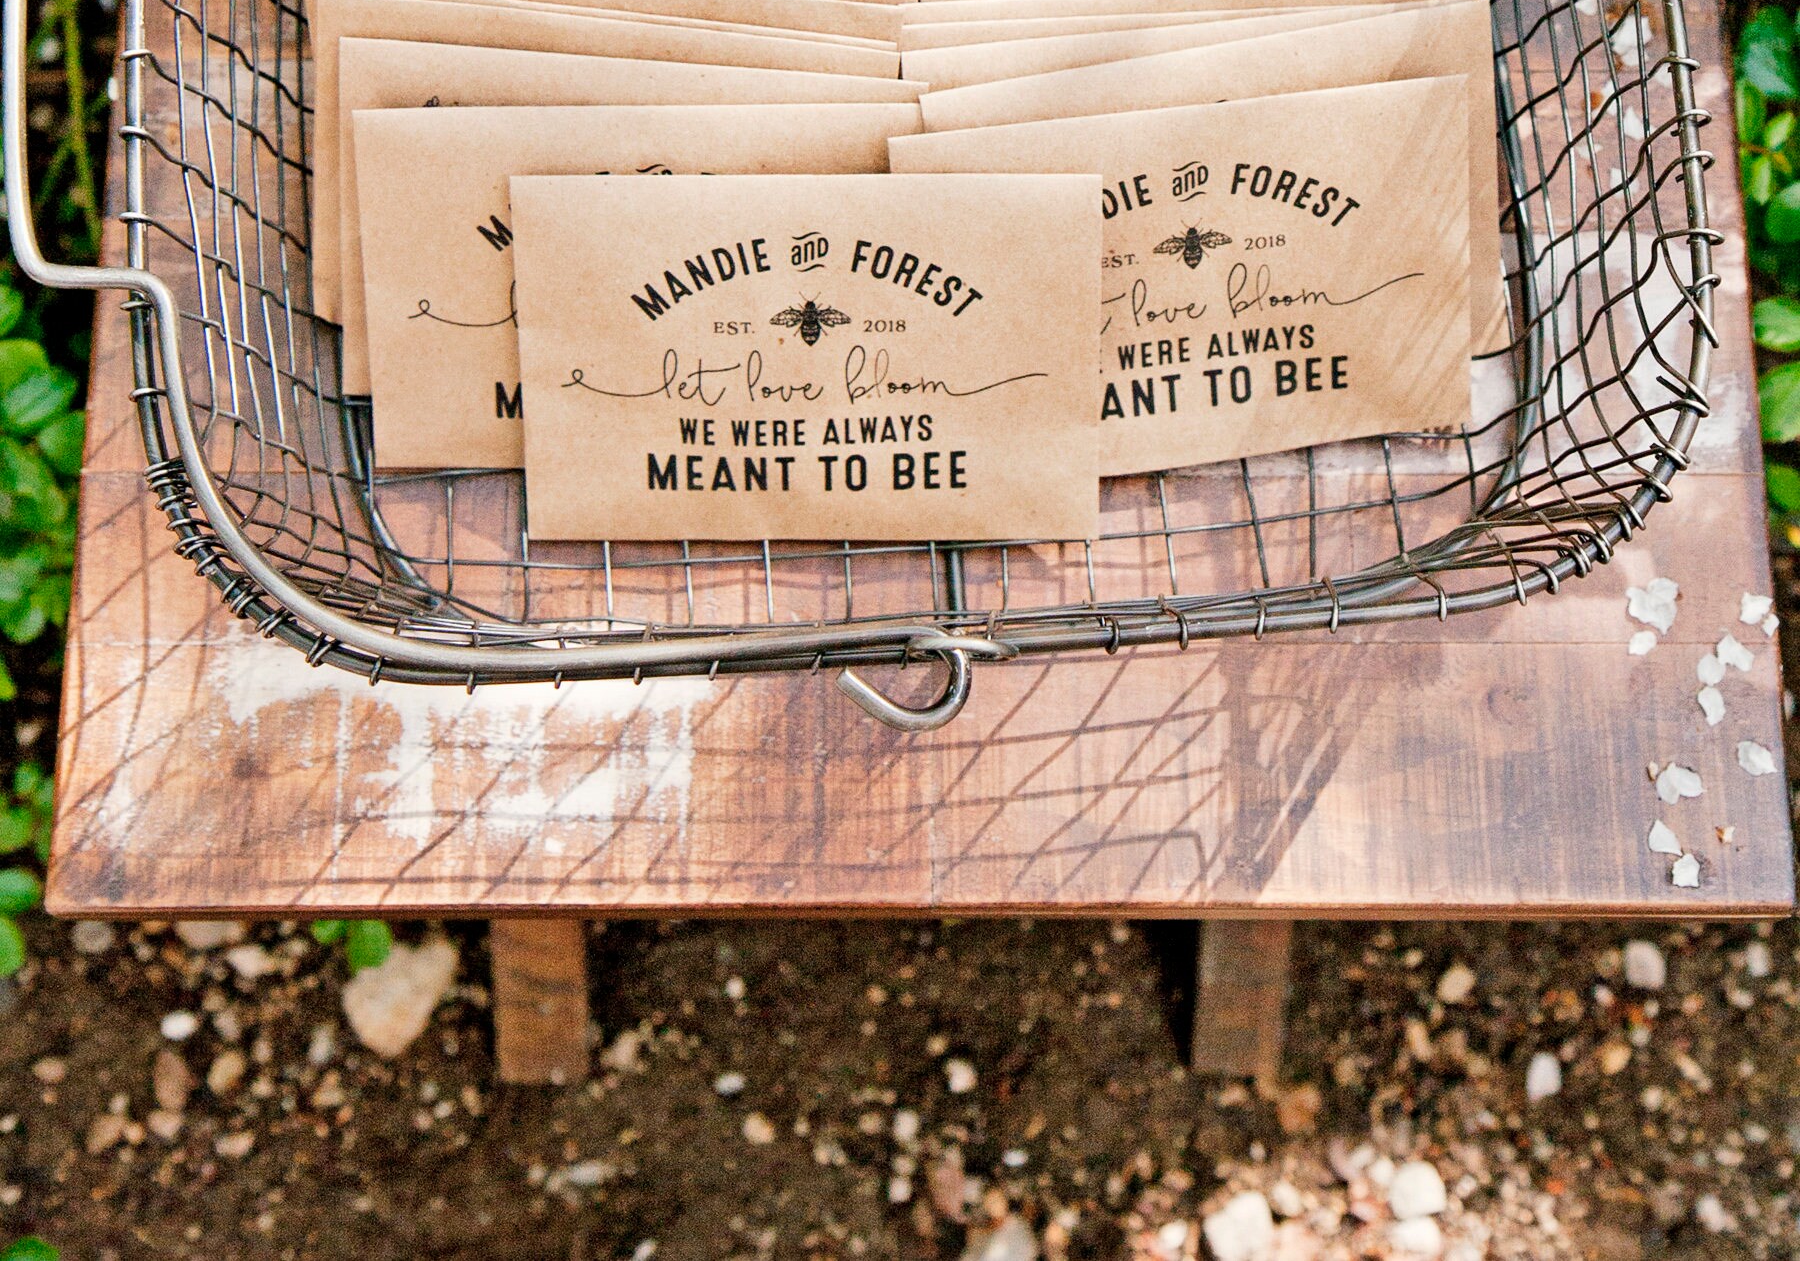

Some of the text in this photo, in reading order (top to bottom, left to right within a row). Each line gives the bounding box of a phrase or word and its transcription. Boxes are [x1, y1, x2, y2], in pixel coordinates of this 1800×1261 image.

[1231, 164, 1360, 226] FOREST
[1245, 235, 1285, 250] 2018
[630, 238, 771, 320] MANDIE
[850, 240, 983, 318] FOREST
[1132, 279, 1206, 327] love
[1228, 263, 1424, 318] bloom
[713, 319, 907, 335] EST. 2018
[1118, 337, 1190, 370] WERE
[1207, 324, 1316, 359] ALWAYS
[747, 350, 823, 402] love
[846, 345, 1048, 404] bloom
[1101, 355, 1348, 420] ANT TO BEE
[680, 414, 932, 446] WE WERE ALWAYS
[648, 451, 967, 491] MEANT TO BEE
